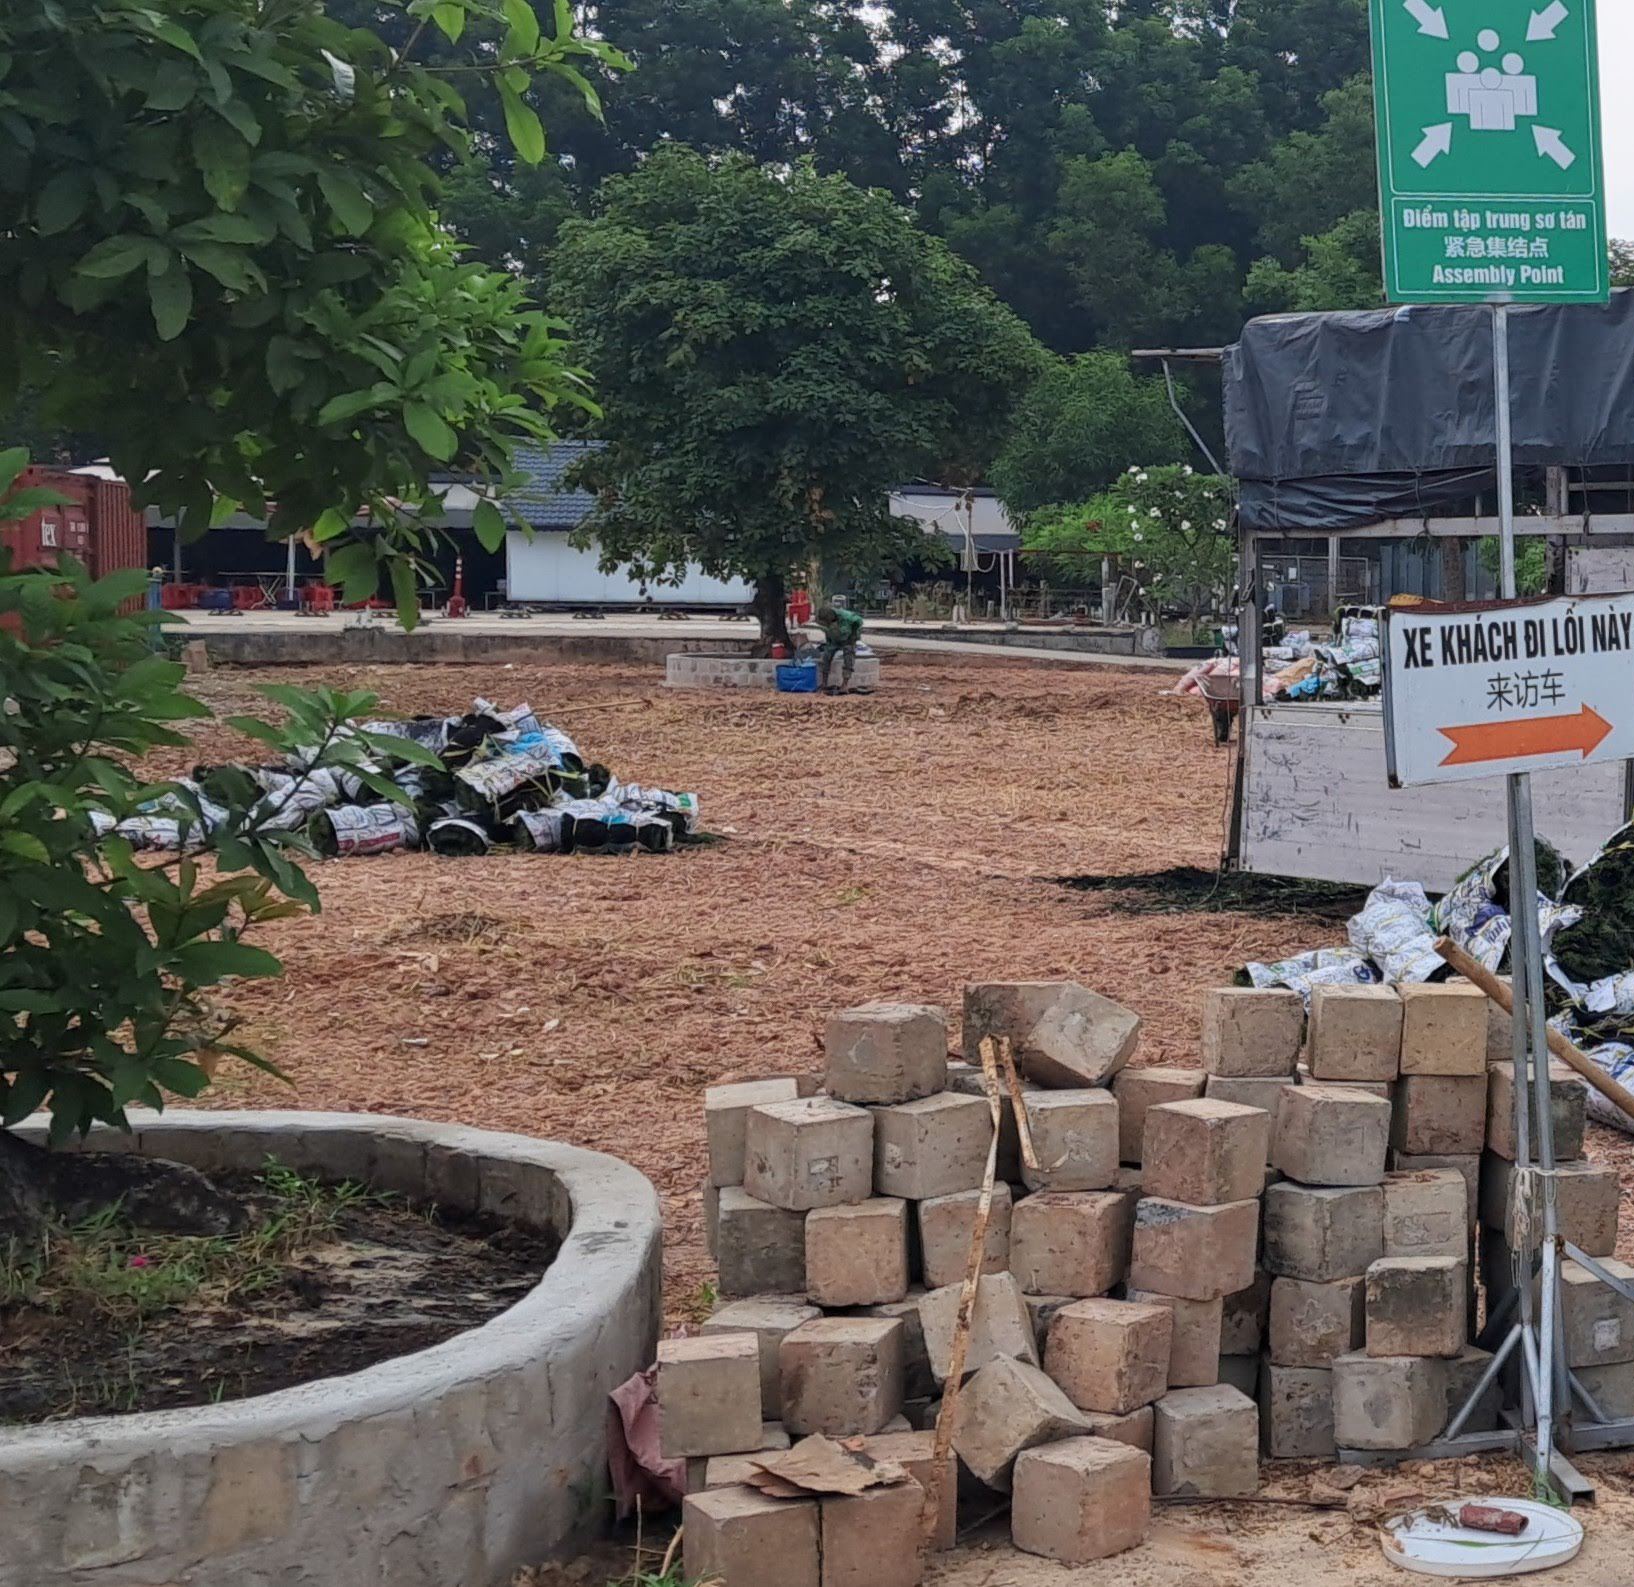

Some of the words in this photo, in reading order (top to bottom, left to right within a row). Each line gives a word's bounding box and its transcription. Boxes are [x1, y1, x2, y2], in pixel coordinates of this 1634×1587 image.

[1403, 204, 1448, 229] Điểm
[1453, 209, 1480, 233] tập
[1485, 209, 1530, 231] trung
[1535, 210, 1556, 229] sơ
[1560, 208, 1586, 230] tán
[1444, 236, 1548, 259] 紧急集结点
[1432, 265, 1515, 287] Assembly
[1520, 266, 1564, 284] Point
[1403, 626, 1434, 669] XE
[1441, 615, 1518, 665] KHÁCH
[1524, 619, 1546, 658] ĐI
[1552, 602, 1584, 656] LỐI
[1592, 605, 1632, 653] NÀY
[1487, 668, 1566, 711] 来访车
